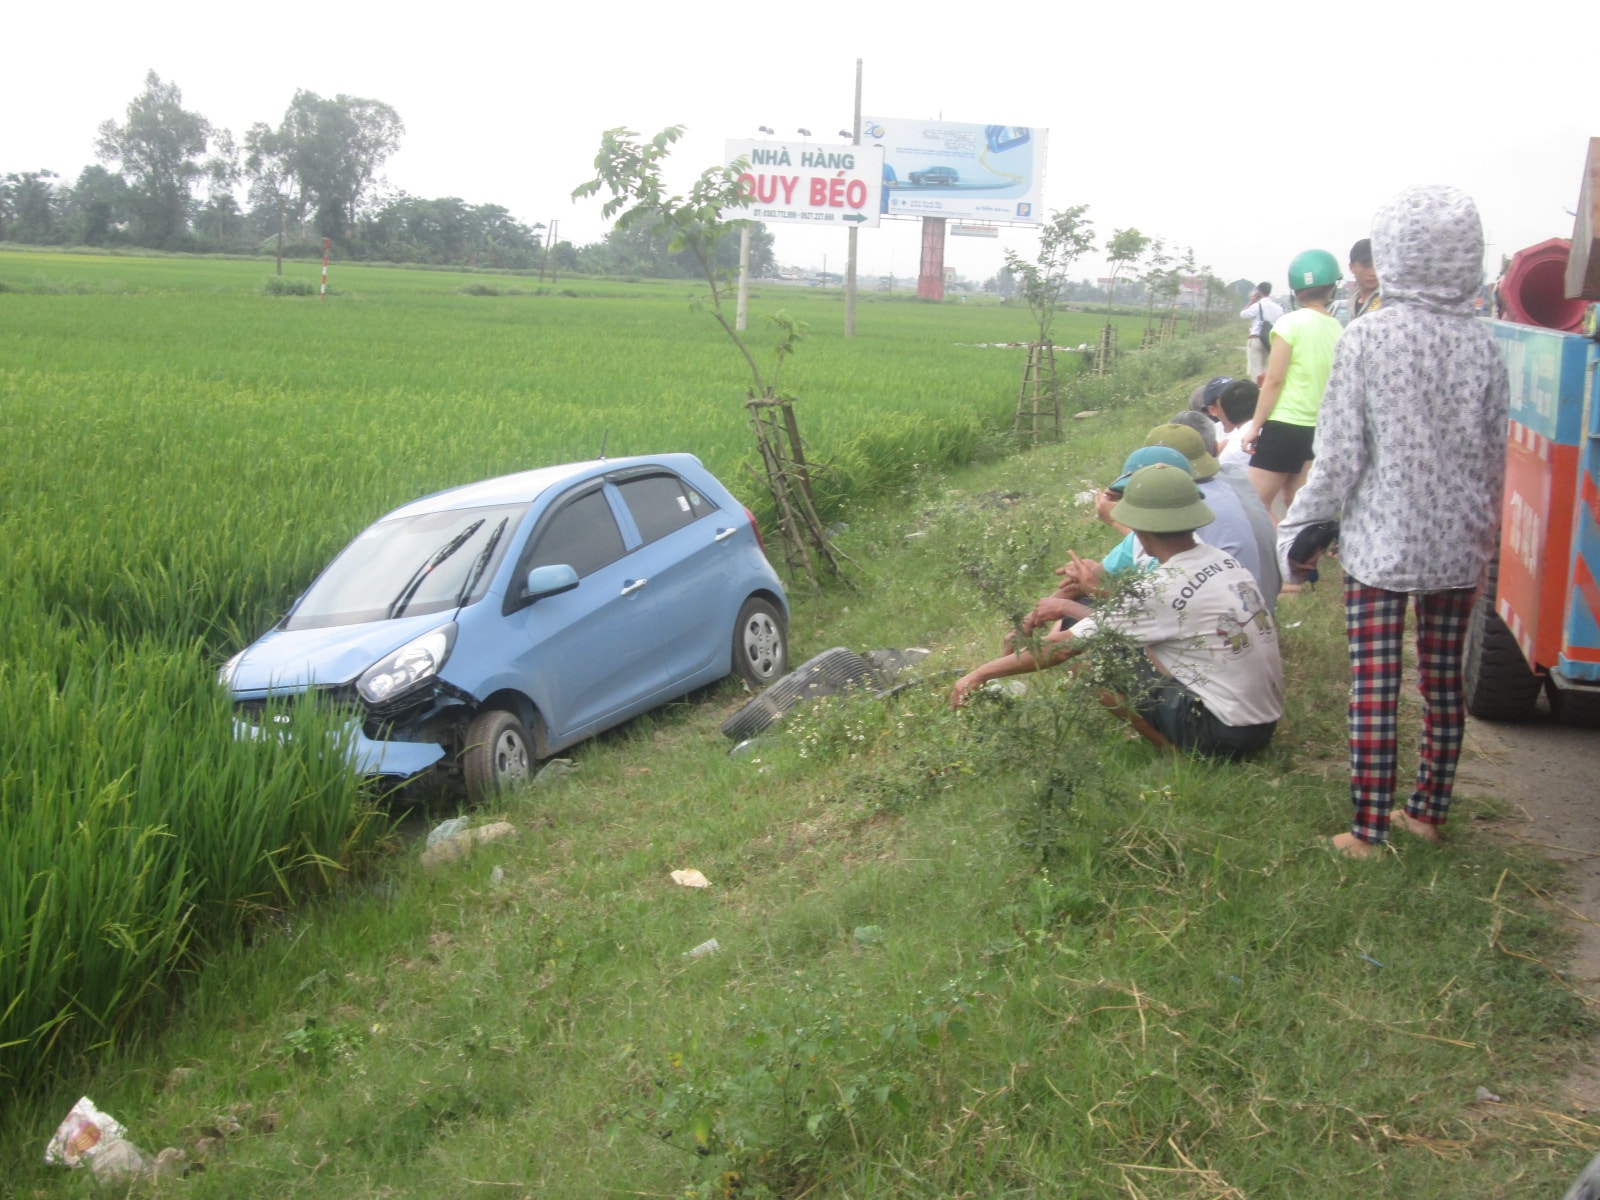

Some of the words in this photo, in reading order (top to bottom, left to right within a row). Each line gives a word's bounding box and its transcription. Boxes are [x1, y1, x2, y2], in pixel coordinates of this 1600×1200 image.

[752, 146, 791, 166] NHÀ
[801, 148, 854, 170] HÀNG
[809, 171, 867, 209] BÉO
[1172, 563, 1223, 611] GOLDEN
